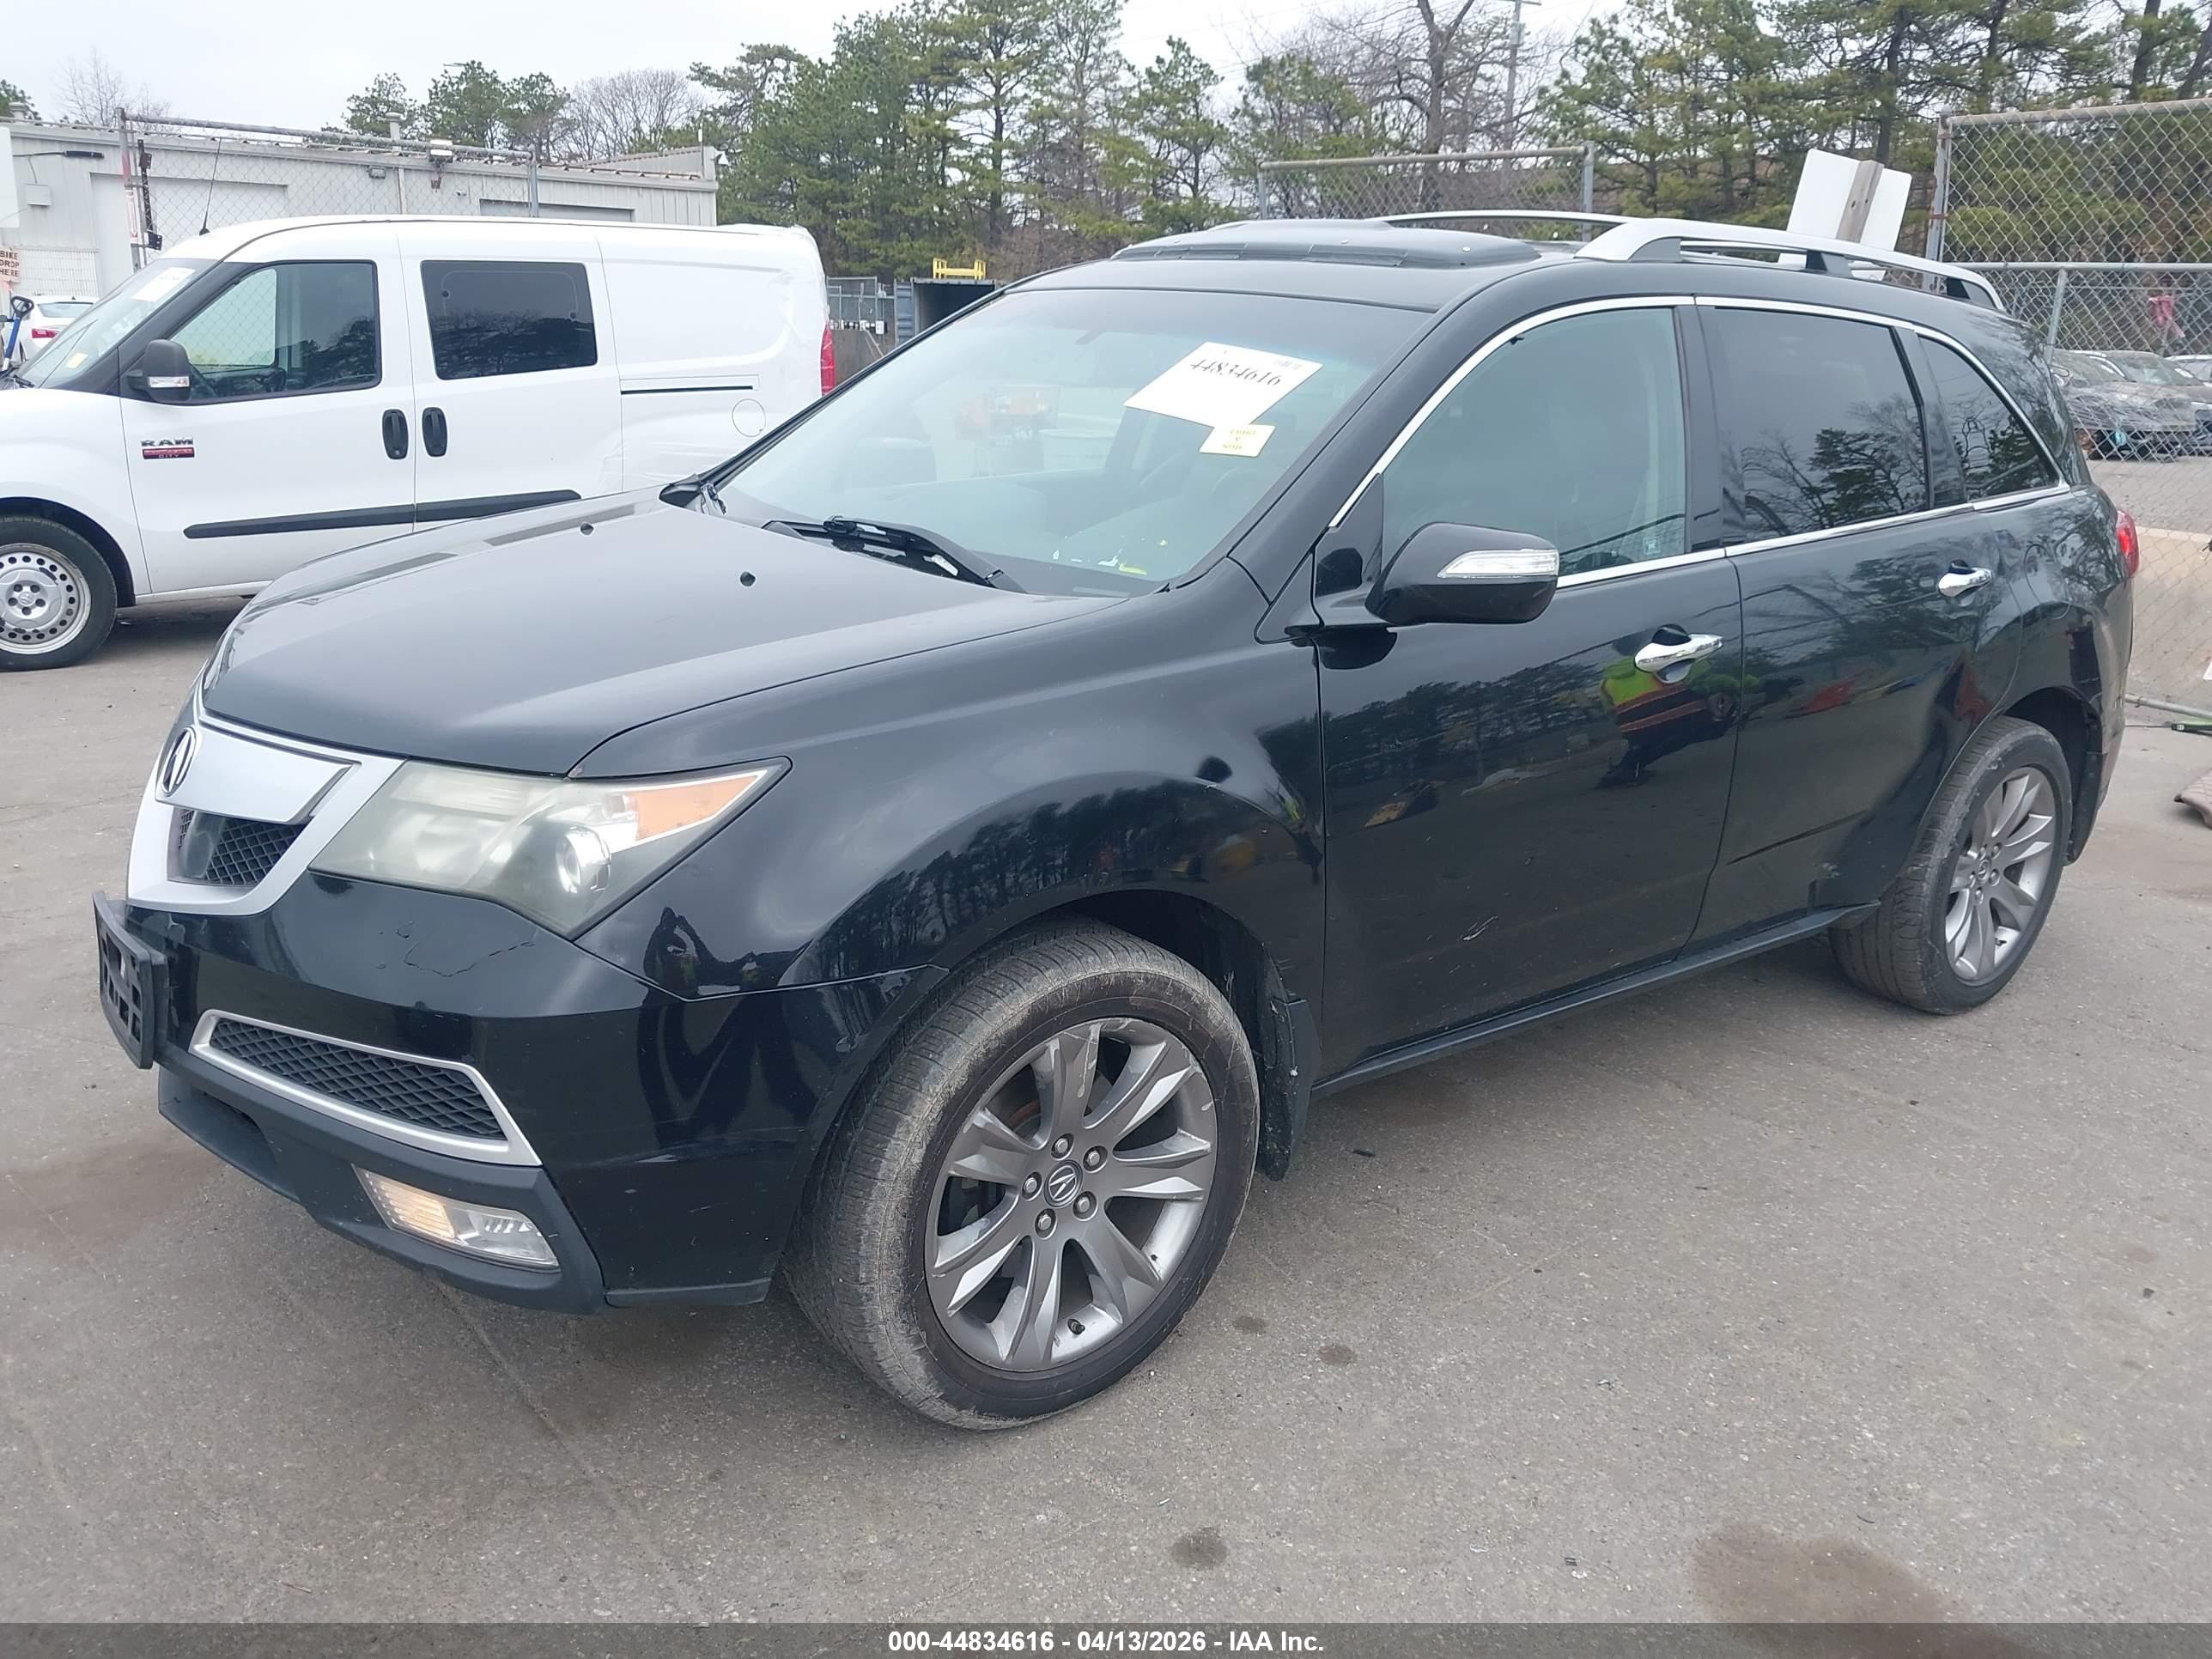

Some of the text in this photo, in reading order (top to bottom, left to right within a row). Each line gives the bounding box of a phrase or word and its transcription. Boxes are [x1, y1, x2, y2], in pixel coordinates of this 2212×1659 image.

[0, 250, 18, 260] BIKE
[0, 258, 20, 269] DROP
[0, 268, 20, 277] HERE
[1190, 358, 1282, 386] 44834616
